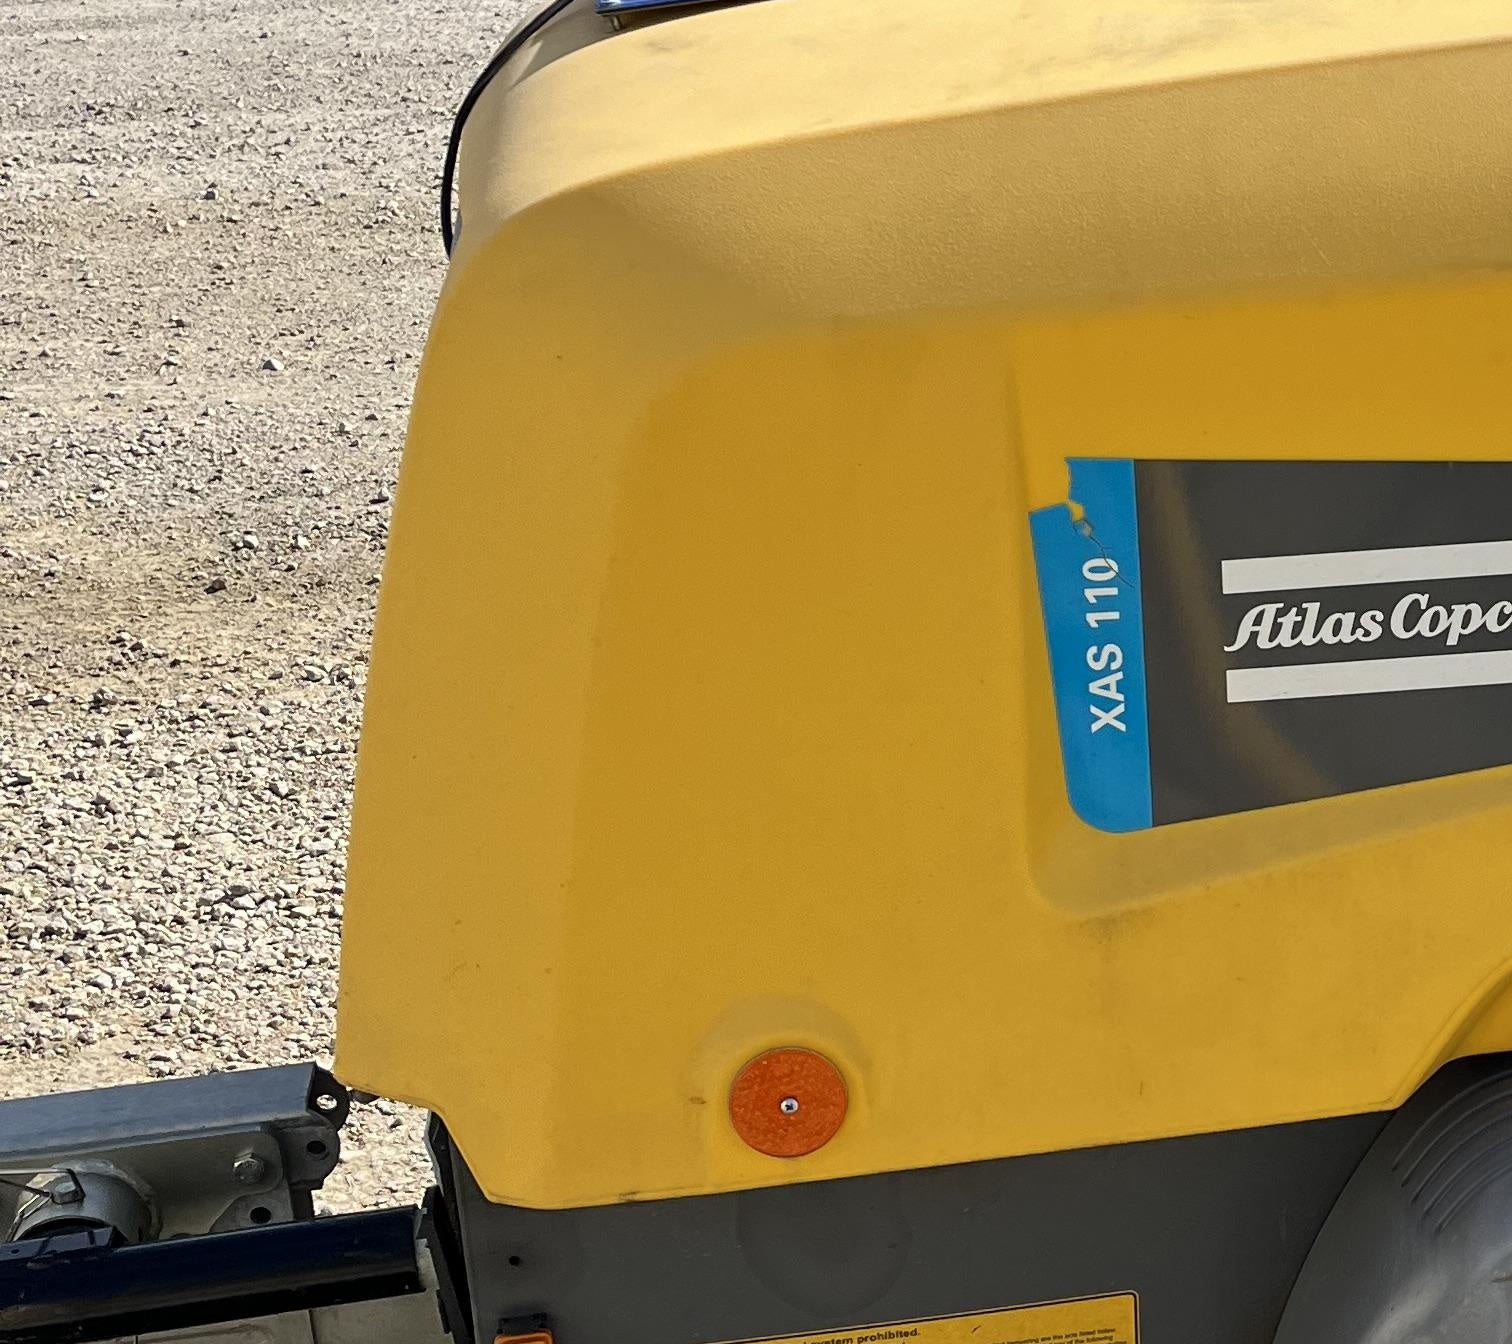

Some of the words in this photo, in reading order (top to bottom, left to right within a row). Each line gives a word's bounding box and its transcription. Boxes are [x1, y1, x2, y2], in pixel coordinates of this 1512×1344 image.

[1081, 556, 1121, 630] 110
[1223, 601, 1385, 653] Atlas
[1086, 643, 1127, 734] XAS
[856, 1327, 920, 1344] prohibited.
